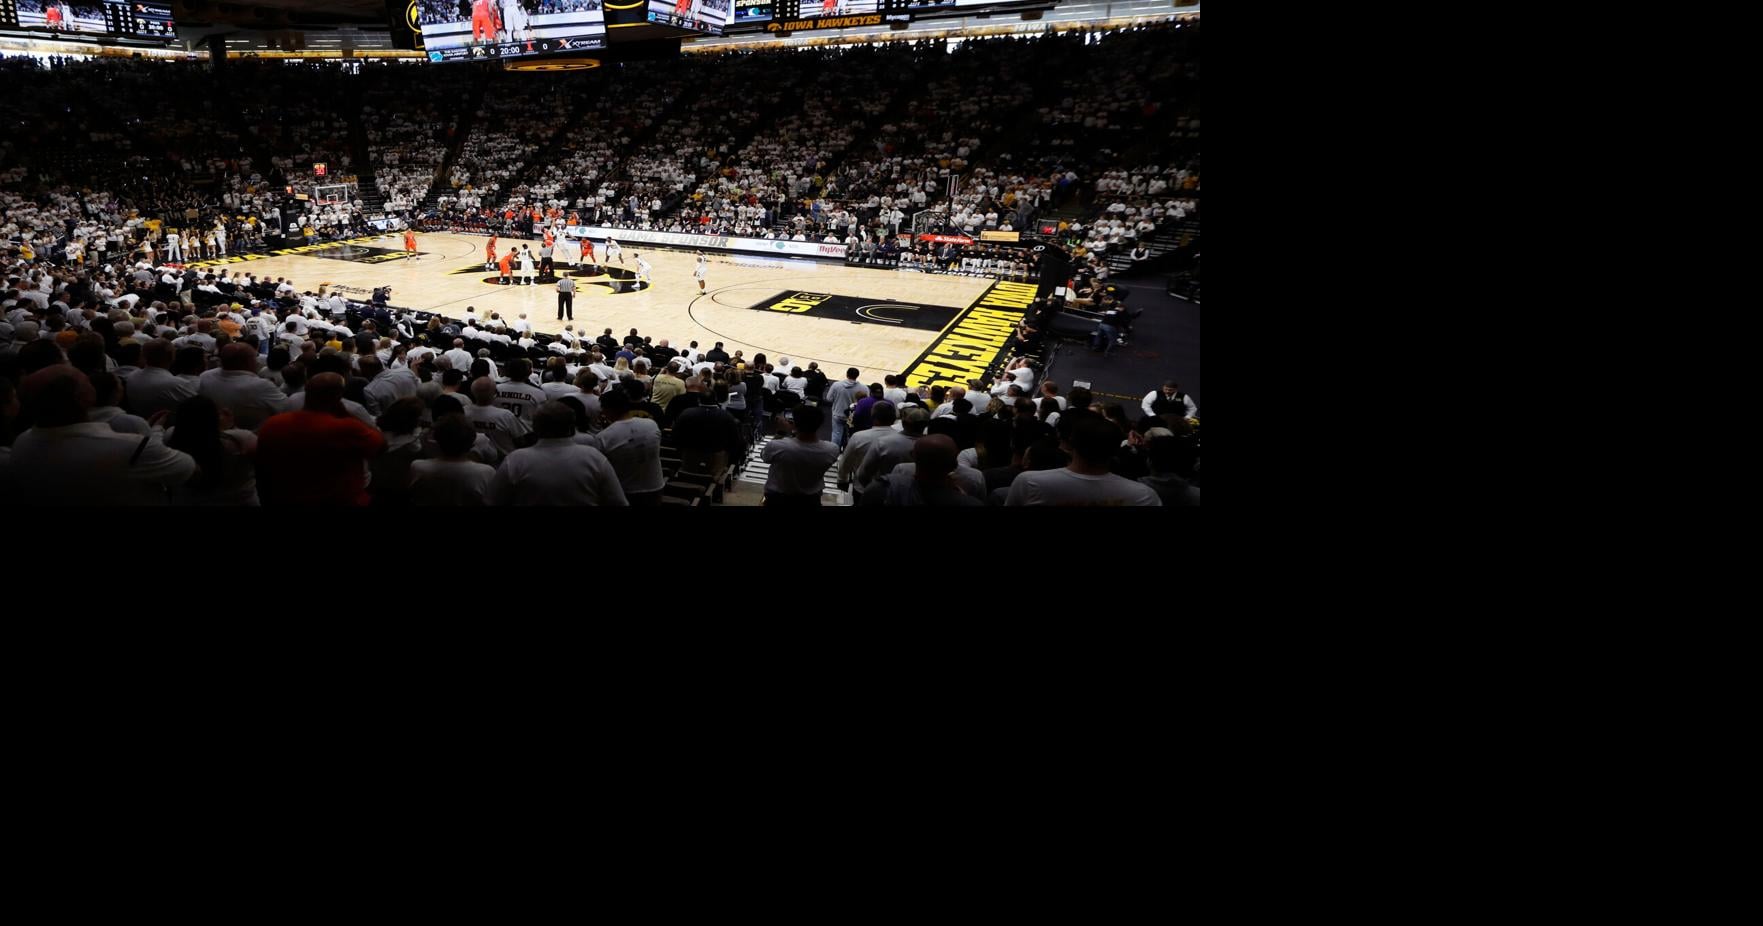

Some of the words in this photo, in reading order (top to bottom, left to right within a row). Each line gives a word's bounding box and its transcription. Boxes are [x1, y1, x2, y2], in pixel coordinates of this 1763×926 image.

[783, 20, 814, 31] IOWA
[816, 14, 882, 29] HAWKEYES
[500, 46, 520, 55] 20:00
[618, 231, 657, 242] GAME
[662, 234, 729, 248] SPONSOR
[979, 280, 1039, 309] IOWA
[905, 307, 1025, 391] HAWKEYES
[496, 391, 531, 401] ARNOLD
